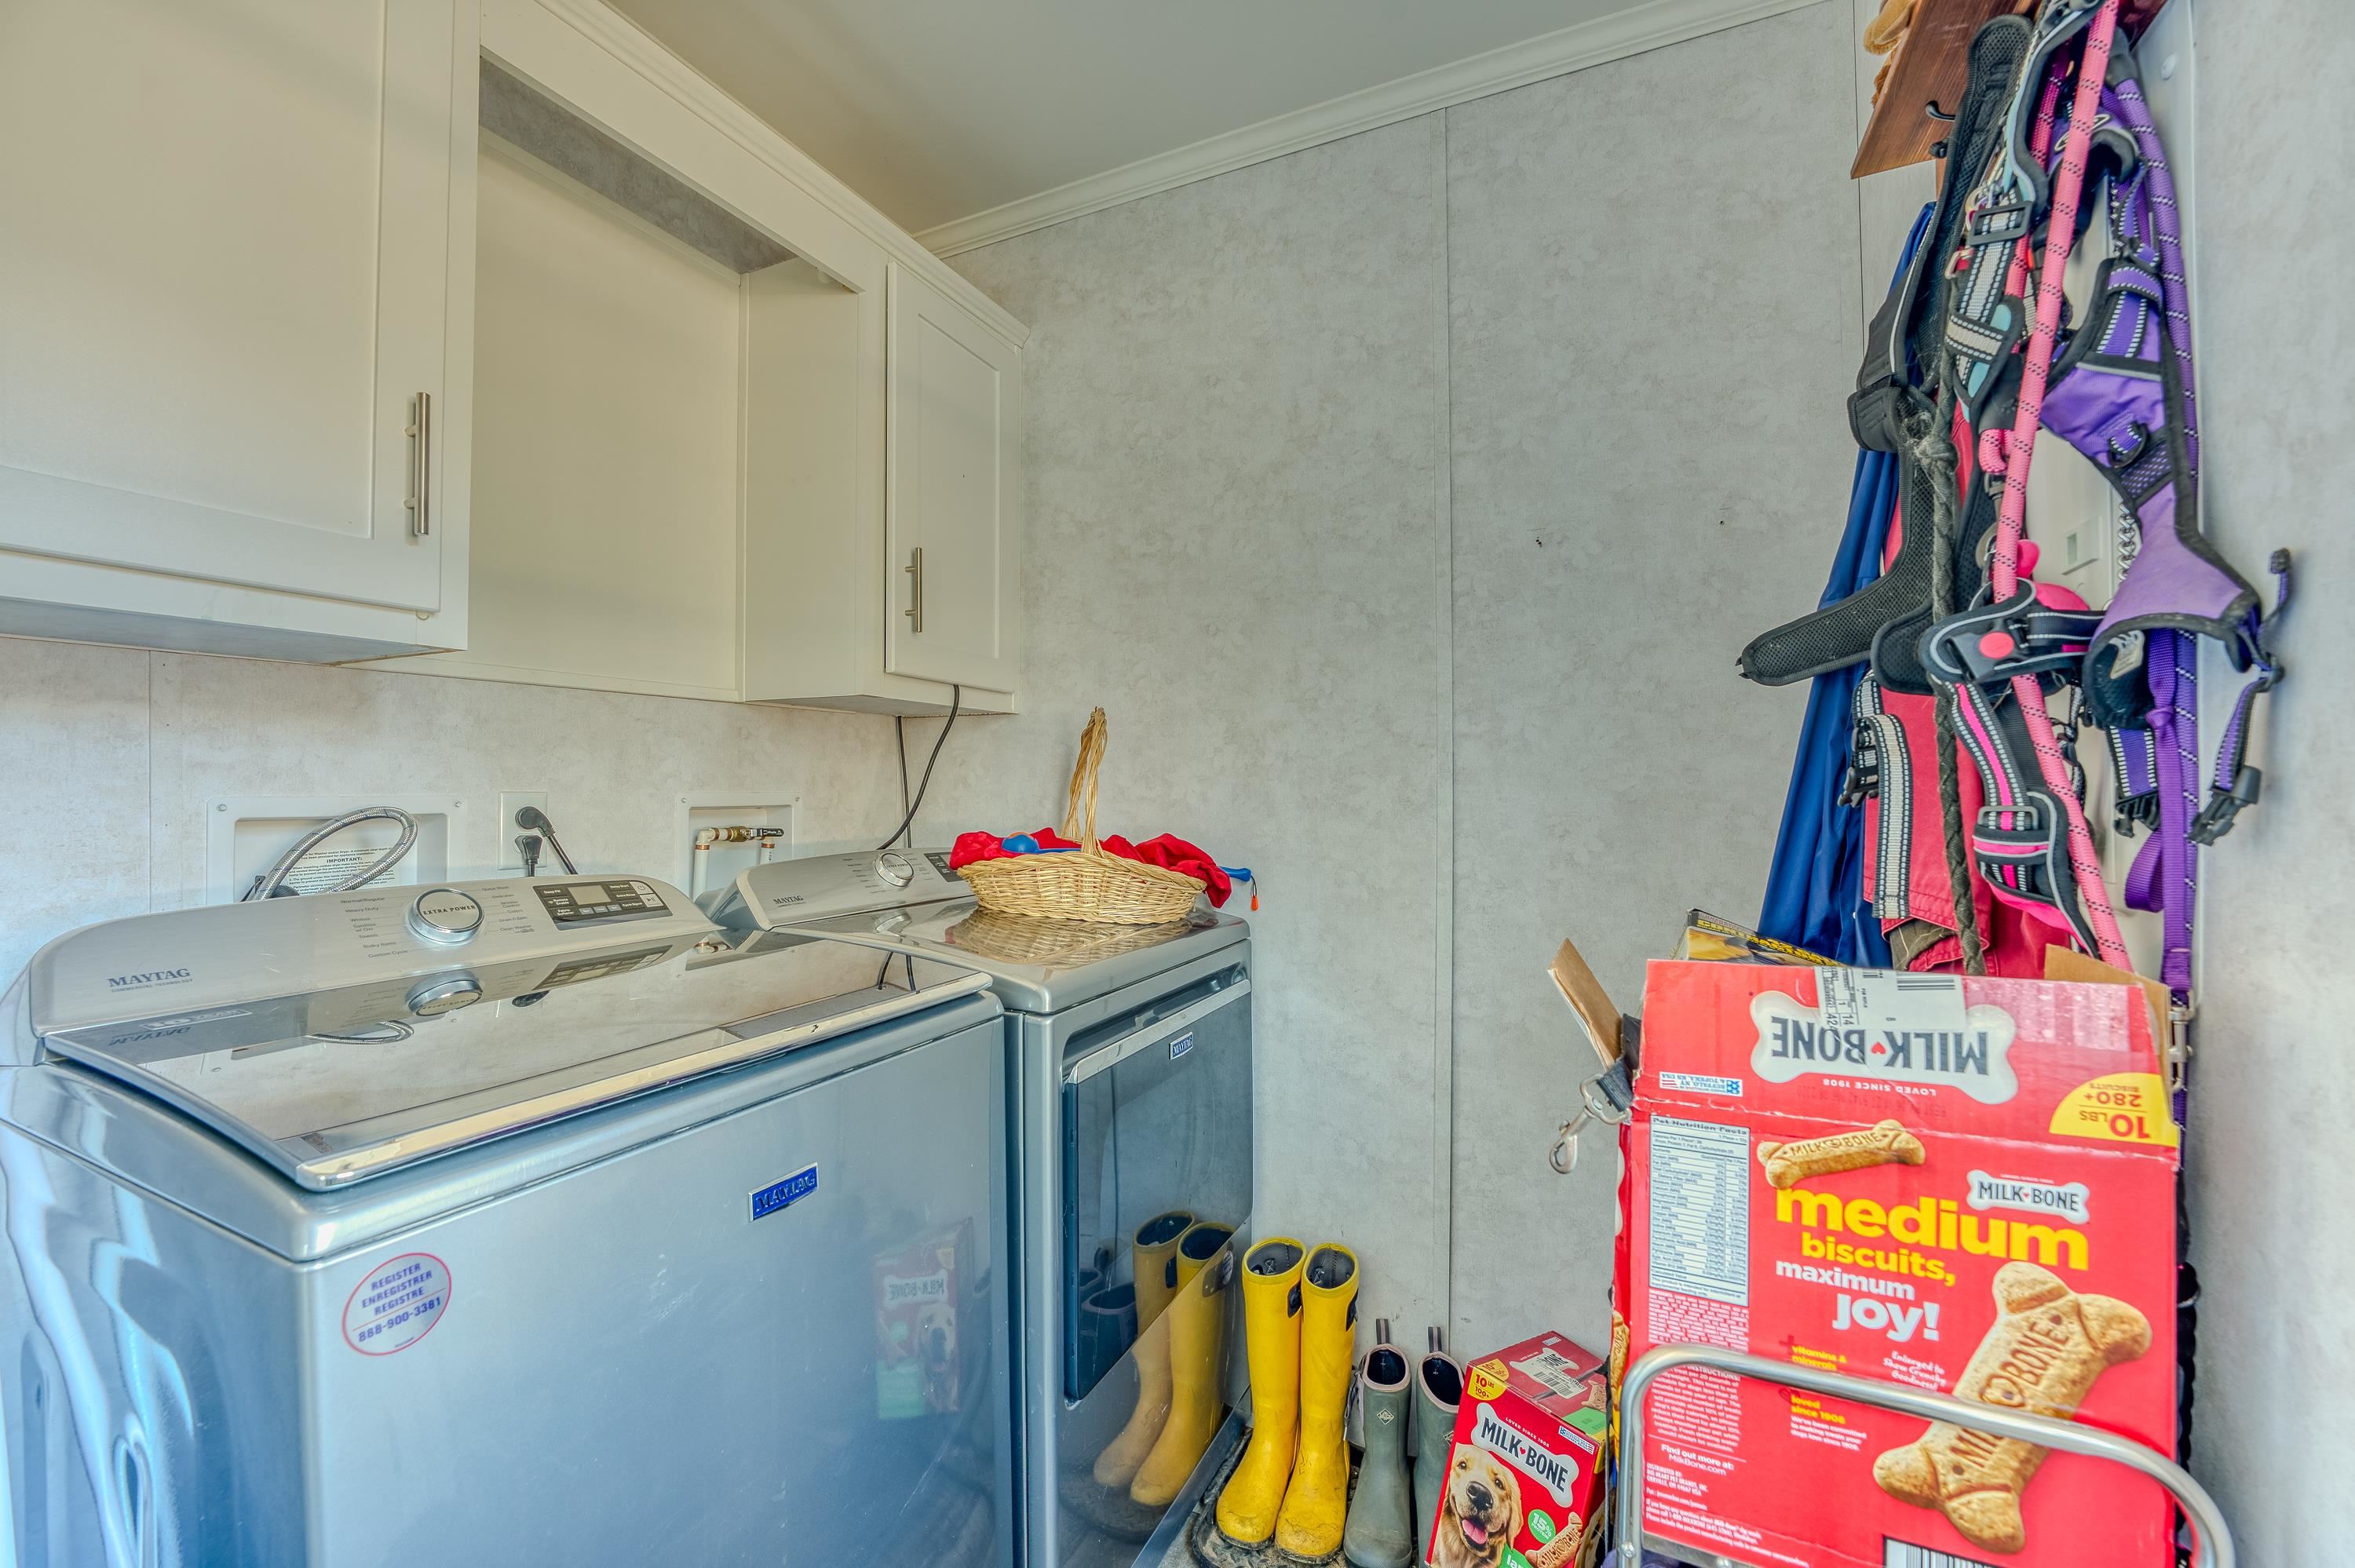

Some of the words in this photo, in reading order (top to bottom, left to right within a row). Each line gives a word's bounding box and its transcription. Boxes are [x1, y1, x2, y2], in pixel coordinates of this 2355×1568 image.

[423, 906, 447, 915] EXTRA
[449, 904, 476, 913] POWER
[772, 895, 804, 905] MAYTAG
[107, 968, 191, 987] MAYTAG
[1173, 1037, 1192, 1056] MAYTAG
[1771, 1016, 1867, 1066] BONE
[1884, 1030, 1989, 1076] MILK
[1823, 1078, 1850, 1088] 1908
[1855, 1081, 1891, 1092] SINCE
[1895, 1085, 1936, 1096] LOVED
[2084, 1092, 2142, 1107] 280+
[1672, 1119, 1716, 1132] Nutrition
[1719, 1126, 1747, 1136] Facts
[2079, 1110, 2108, 1122] LBS
[2110, 1114, 2151, 1138] 10
[1791, 1140, 1825, 1156] MILK
[1844, 1132, 1881, 1147] BONE
[755, 1172, 816, 1212] MAYTAG
[1978, 1180, 2024, 1202] MILK
[2032, 1187, 2079, 1212] BONE
[1776, 1187, 2089, 1271] medium
[1802, 1231, 1956, 1288] biscuits,
[371, 1262, 421, 1292] REGISTER
[1776, 1260, 1915, 1301] maximum
[362, 1270, 433, 1309] ENREGISTRER
[374, 1286, 425, 1316] REGISTRE
[359, 1296, 440, 1342] 888-900-3381
[1791, 1345, 1838, 1362] vitamins
[1791, 1355, 1837, 1371] minerals
[1475, 1373, 1488, 1387] 10
[1474, 1386, 1490, 1398] 100+
[1791, 1395, 1820, 1409] loved
[1791, 1405, 1818, 1418] since
[1820, 1411, 1846, 1424] 1908
[1506, 1417, 1521, 1430] LOVED
[1522, 1427, 1537, 1440] SINCE
[1538, 1435, 1550, 1448] 1908
[1481, 1416, 1523, 1460] MILK
[1525, 1446, 1568, 1493] BONE
[1661, 1443, 1680, 1455] Find
[1681, 1448, 1696, 1460] out
[1697, 1453, 1721, 1466] more
[1722, 1459, 1733, 1469] at:
[1668, 1453, 1725, 1476] MilkBone.com
[1532, 1512, 1552, 1537] 15%
